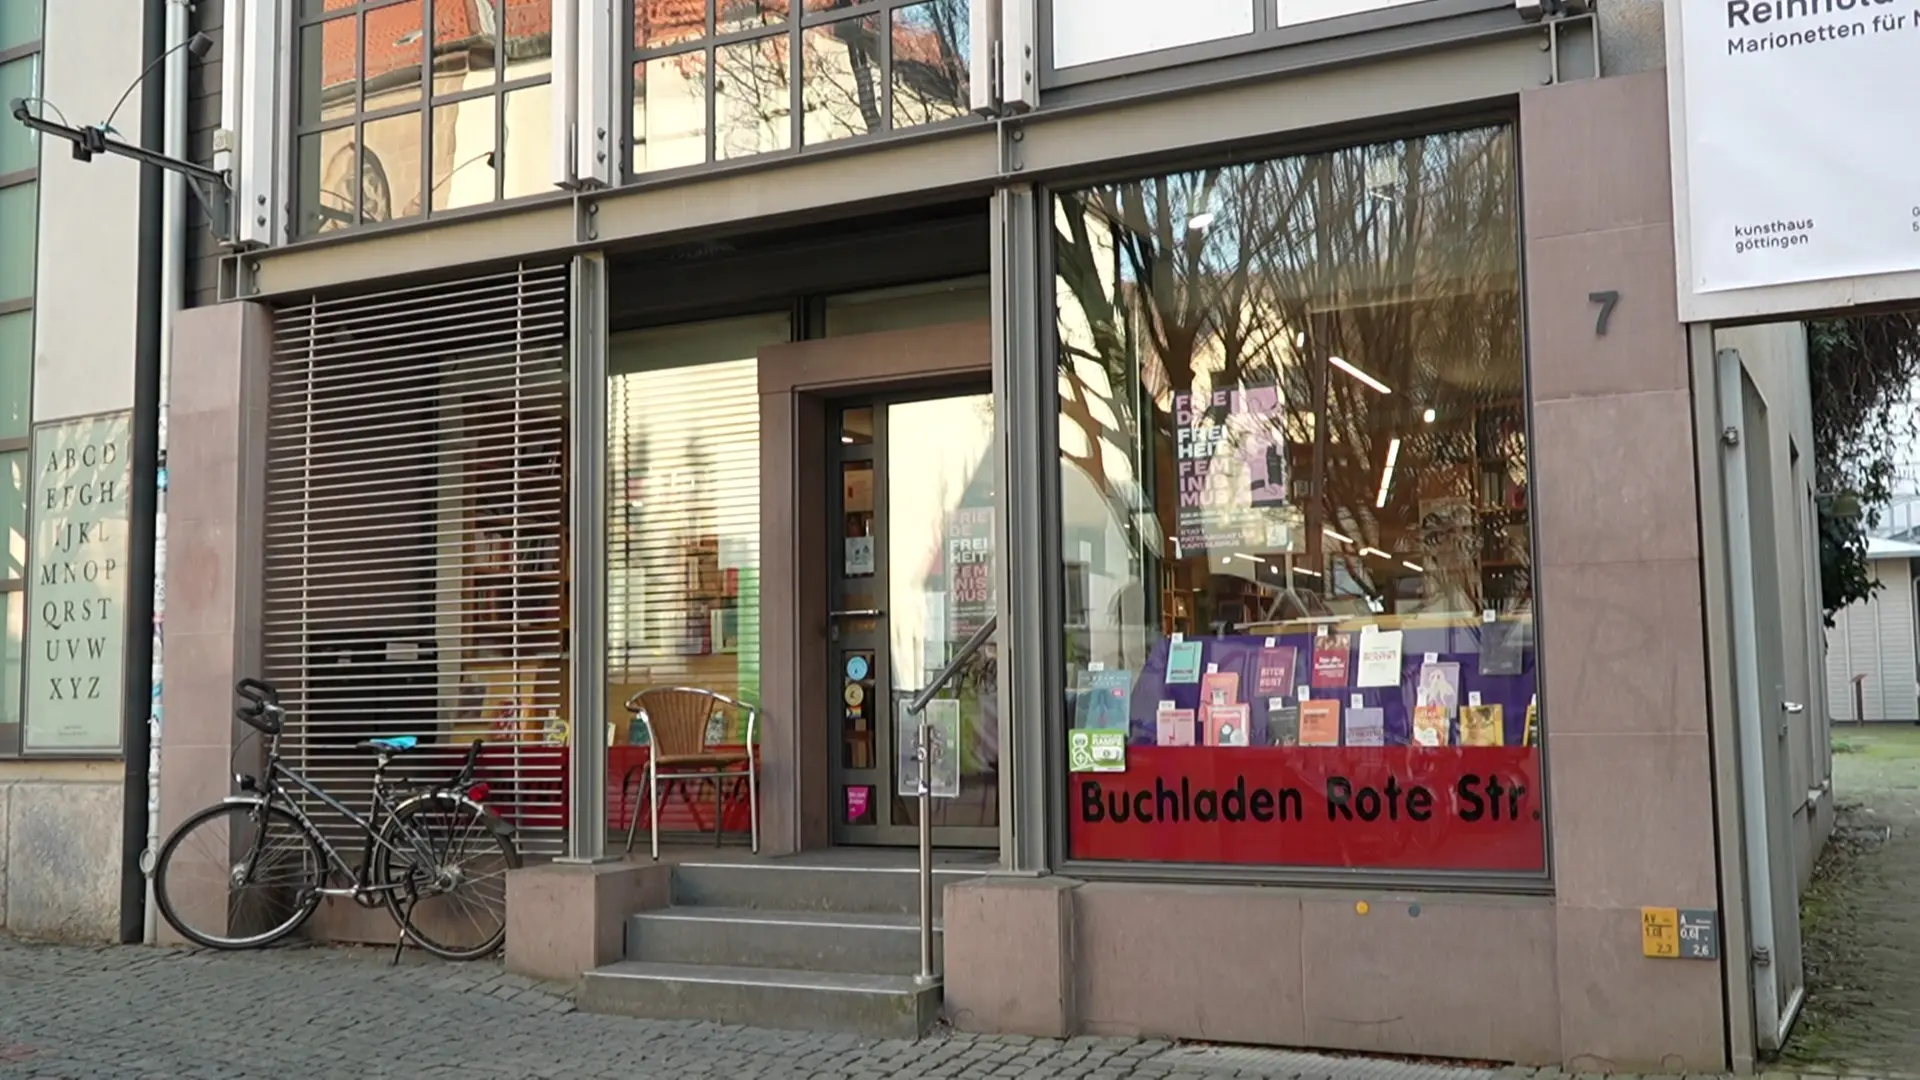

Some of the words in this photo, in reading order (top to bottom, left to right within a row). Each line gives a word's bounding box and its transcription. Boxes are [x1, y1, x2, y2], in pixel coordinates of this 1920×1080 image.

[1728, 22, 1865, 55] Marionetten
[1872, 14, 1906, 33] für
[1735, 219, 1814, 237] kunsthaus
[1735, 234, 1809, 254] göttingen
[1588, 290, 1620, 337] 7
[950, 538, 987, 551] FREI
[950, 551, 987, 564] HEIT
[951, 565, 988, 578] FEM
[951, 590, 987, 602] MUS
[1081, 775, 1302, 824] Buchladen
[1327, 775, 1432, 822] Rote
[1458, 773, 1541, 822] Str.
